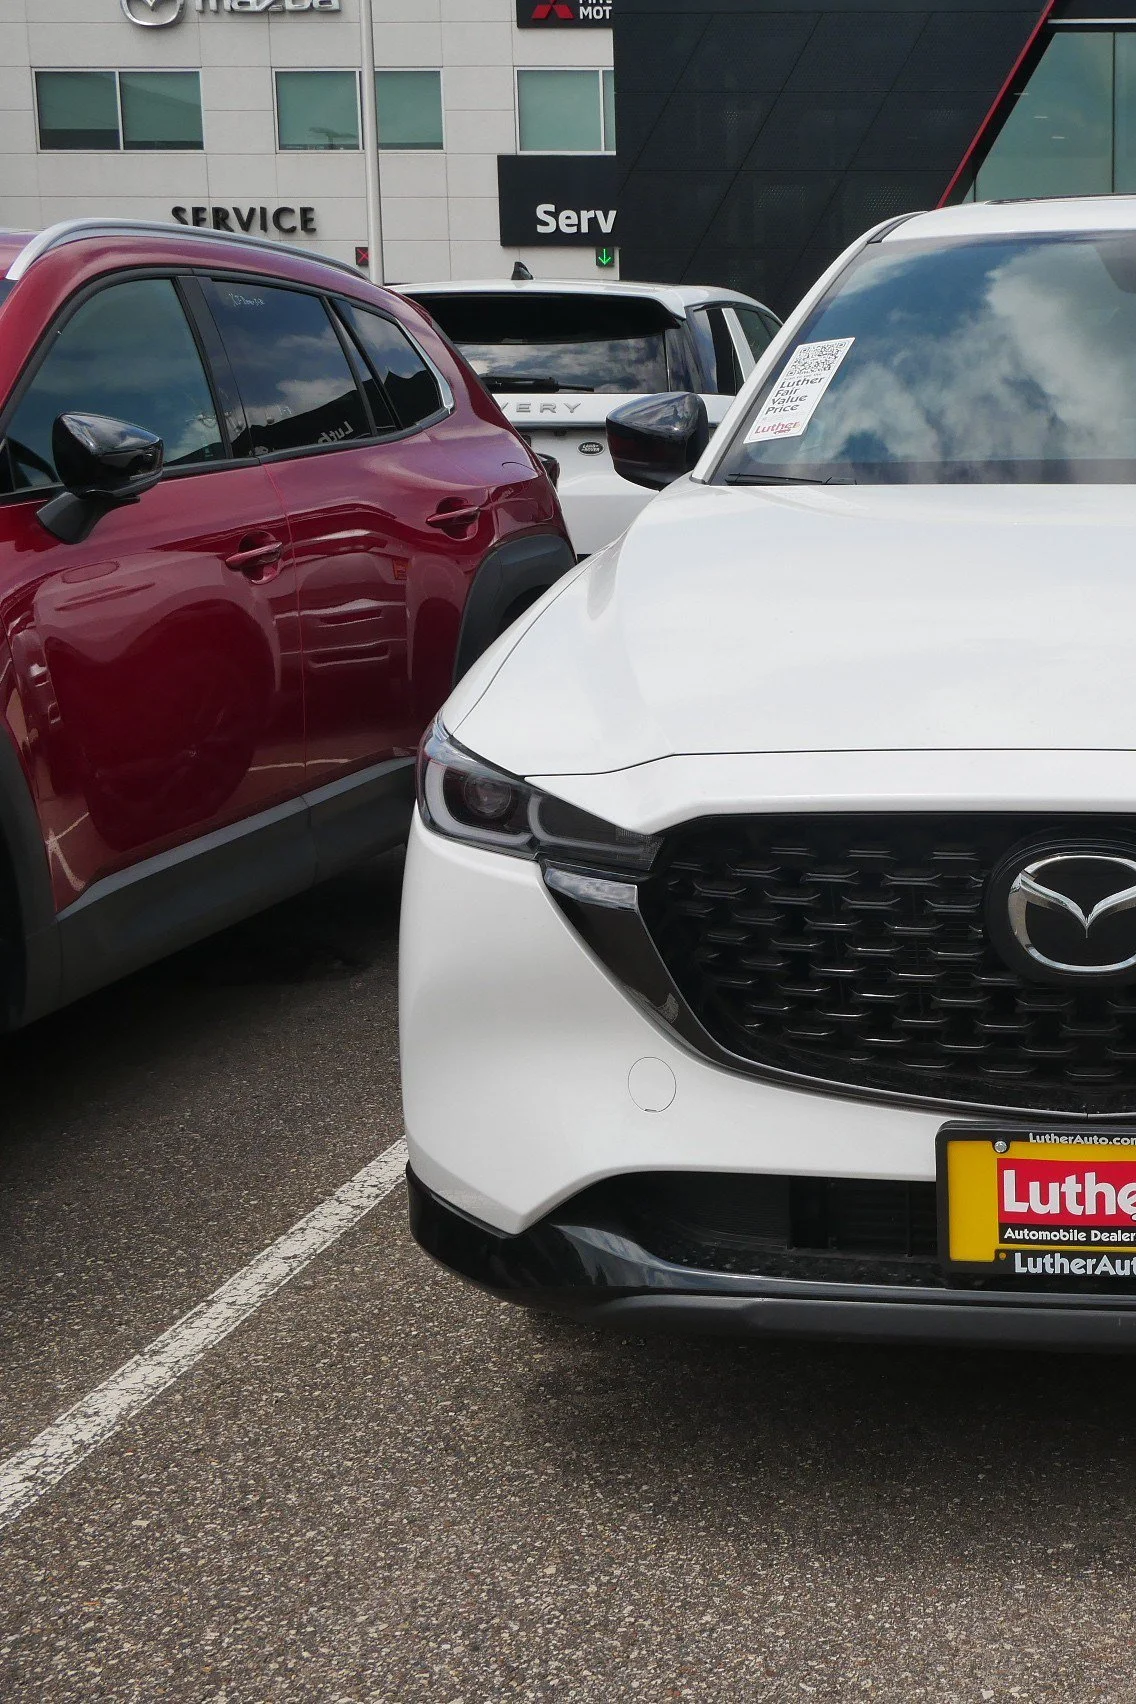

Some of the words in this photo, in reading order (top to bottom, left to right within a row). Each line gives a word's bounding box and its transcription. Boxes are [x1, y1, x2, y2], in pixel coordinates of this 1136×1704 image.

[579, 6, 612, 19] MOT
[171, 206, 316, 233] SERVICE
[535, 203, 617, 234] Serv
[780, 377, 825, 389] Luther
[774, 387, 800, 397] Fair
[772, 396, 808, 405] Value
[765, 404, 800, 415] Price
[754, 421, 801, 434] Luther
[1004, 1228, 1087, 1242] Automobile
